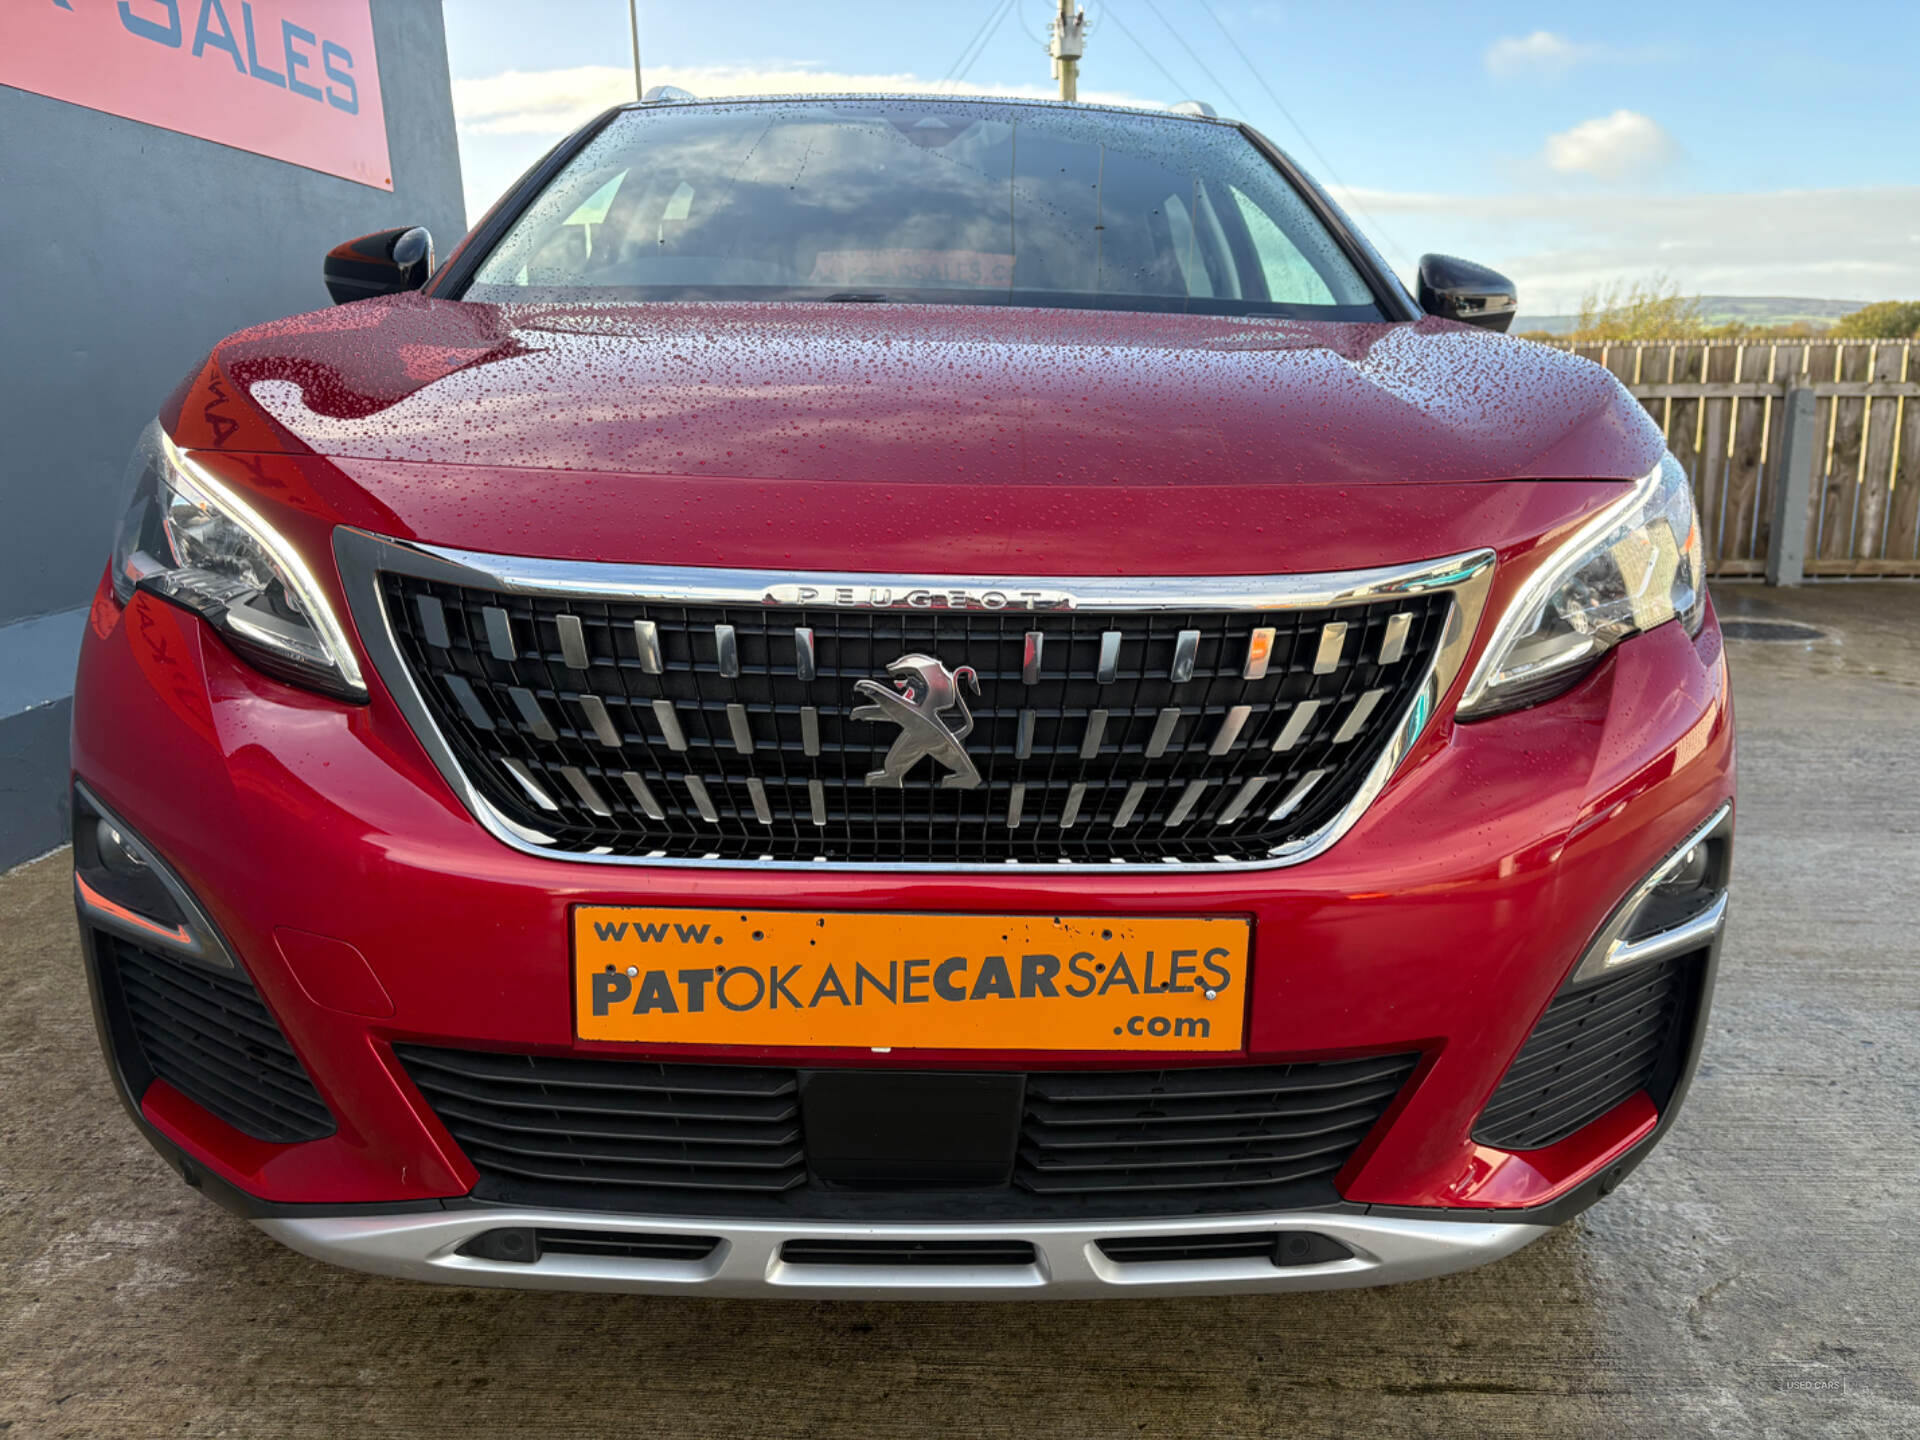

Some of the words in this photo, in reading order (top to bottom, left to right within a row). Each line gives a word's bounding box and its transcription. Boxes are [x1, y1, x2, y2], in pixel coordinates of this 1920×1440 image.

[796, 586, 1042, 609] PEUGEOT
[594, 921, 724, 945] www.
[591, 947, 1231, 1017] PATOKANECARSALES
[1113, 1015, 1211, 1038] .com
